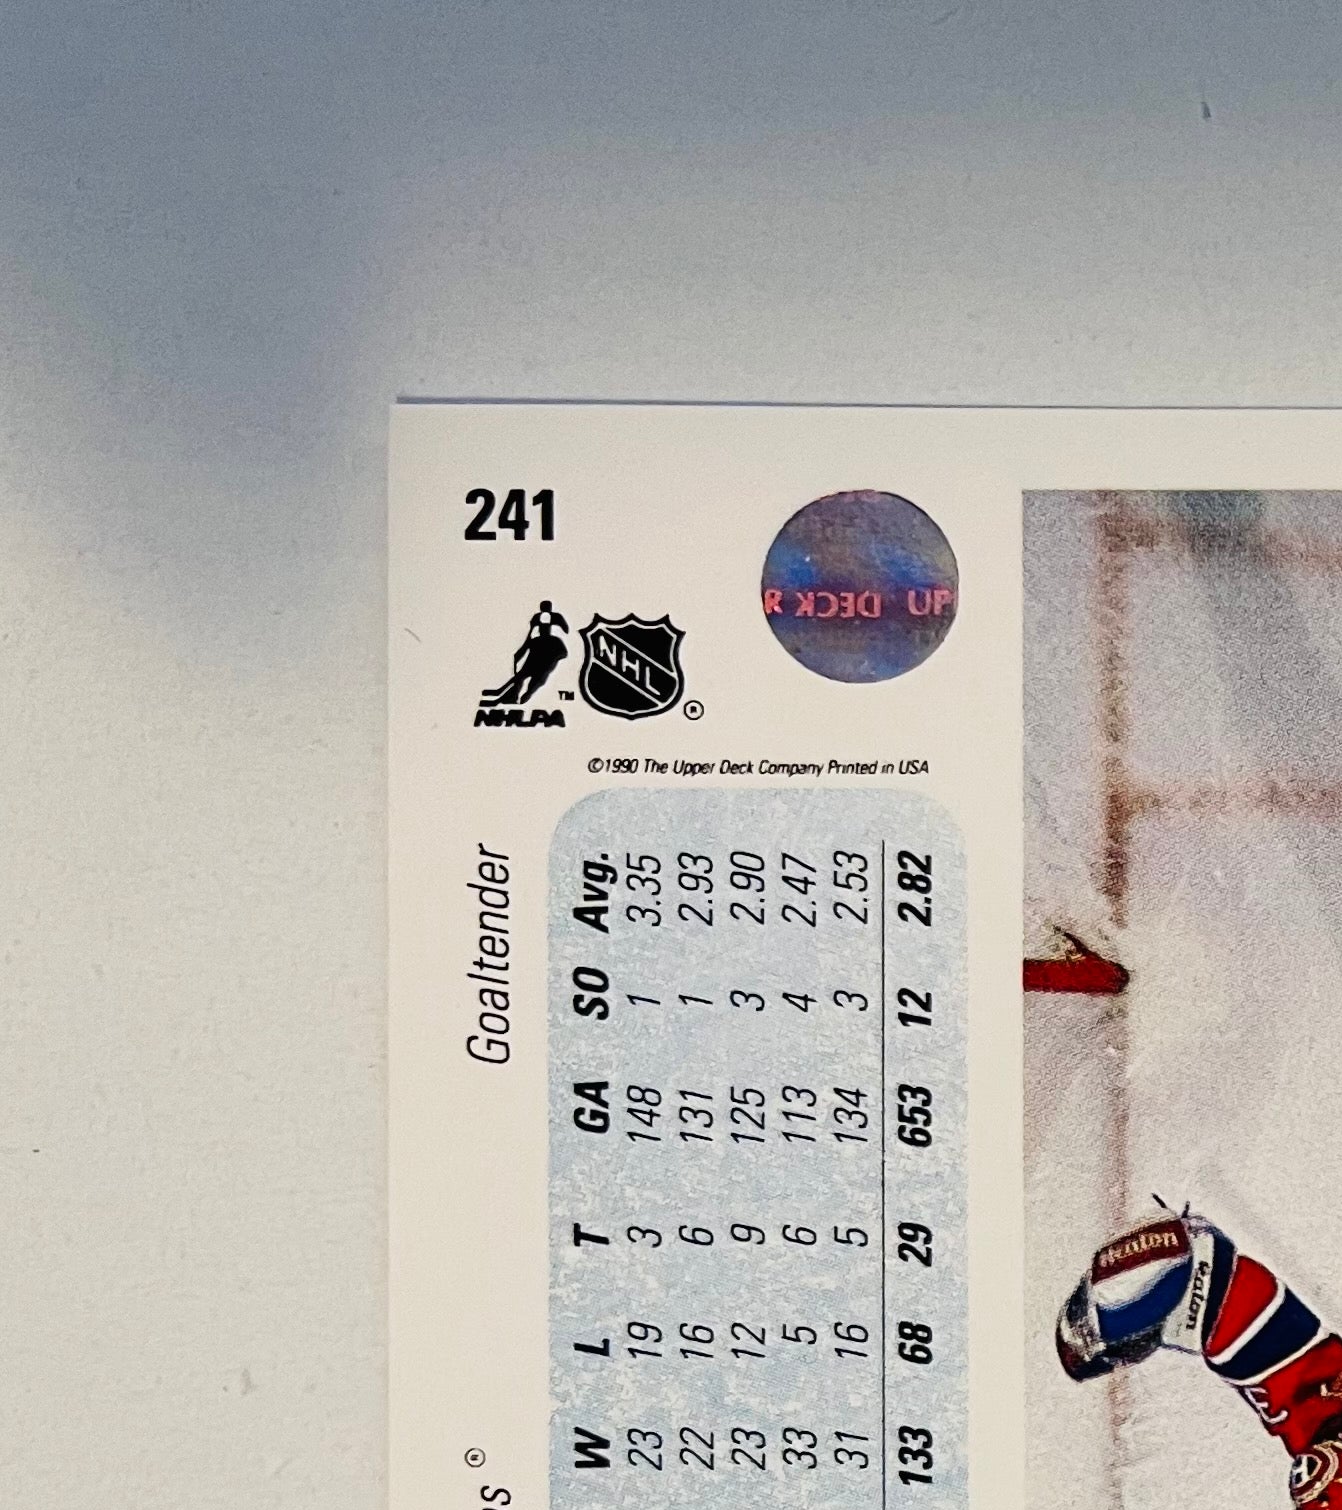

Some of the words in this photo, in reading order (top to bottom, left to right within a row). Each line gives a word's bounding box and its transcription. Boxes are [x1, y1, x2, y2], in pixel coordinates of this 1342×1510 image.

[465, 489, 553, 540] 241
[599, 634, 661, 696] NHL
[474, 709, 565, 727] NHLPA
[645, 758, 668, 774] The
[673, 759, 715, 777] Upper
[720, 759, 753, 775] Deck
[758, 760, 823, 778] Company
[827, 759, 878, 775] Printed
[881, 762, 894, 775] in
[899, 759, 930, 775] USA
[573, 854, 617, 933] Avg.
[626, 853, 661, 926] 3.35
[730, 852, 765, 924] 2.90
[898, 851, 931, 926] 2.82
[467, 843, 509, 1064] Goaltender
[573, 967, 609, 1020] SO
[627, 995, 660, 1005] 1
[730, 990, 764, 1011] 3
[897, 988, 931, 1026] 12
[573, 1081, 609, 1133] GA
[627, 1085, 661, 1141] 148
[730, 1087, 765, 1143] 125
[898, 1084, 932, 1147] 653
[573, 1223, 609, 1246] T
[627, 1226, 662, 1248] 3
[731, 1224, 765, 1244] 9
[898, 1223, 932, 1267] 29
[573, 1339, 609, 1356] L
[628, 1322, 662, 1358] 19
[731, 1323, 765, 1358] 12
[898, 1321, 932, 1364] 68
[574, 1427, 610, 1468] W
[627, 1429, 662, 1470] 23
[731, 1428, 766, 1470] 23
[898, 1426, 933, 1485] 133
